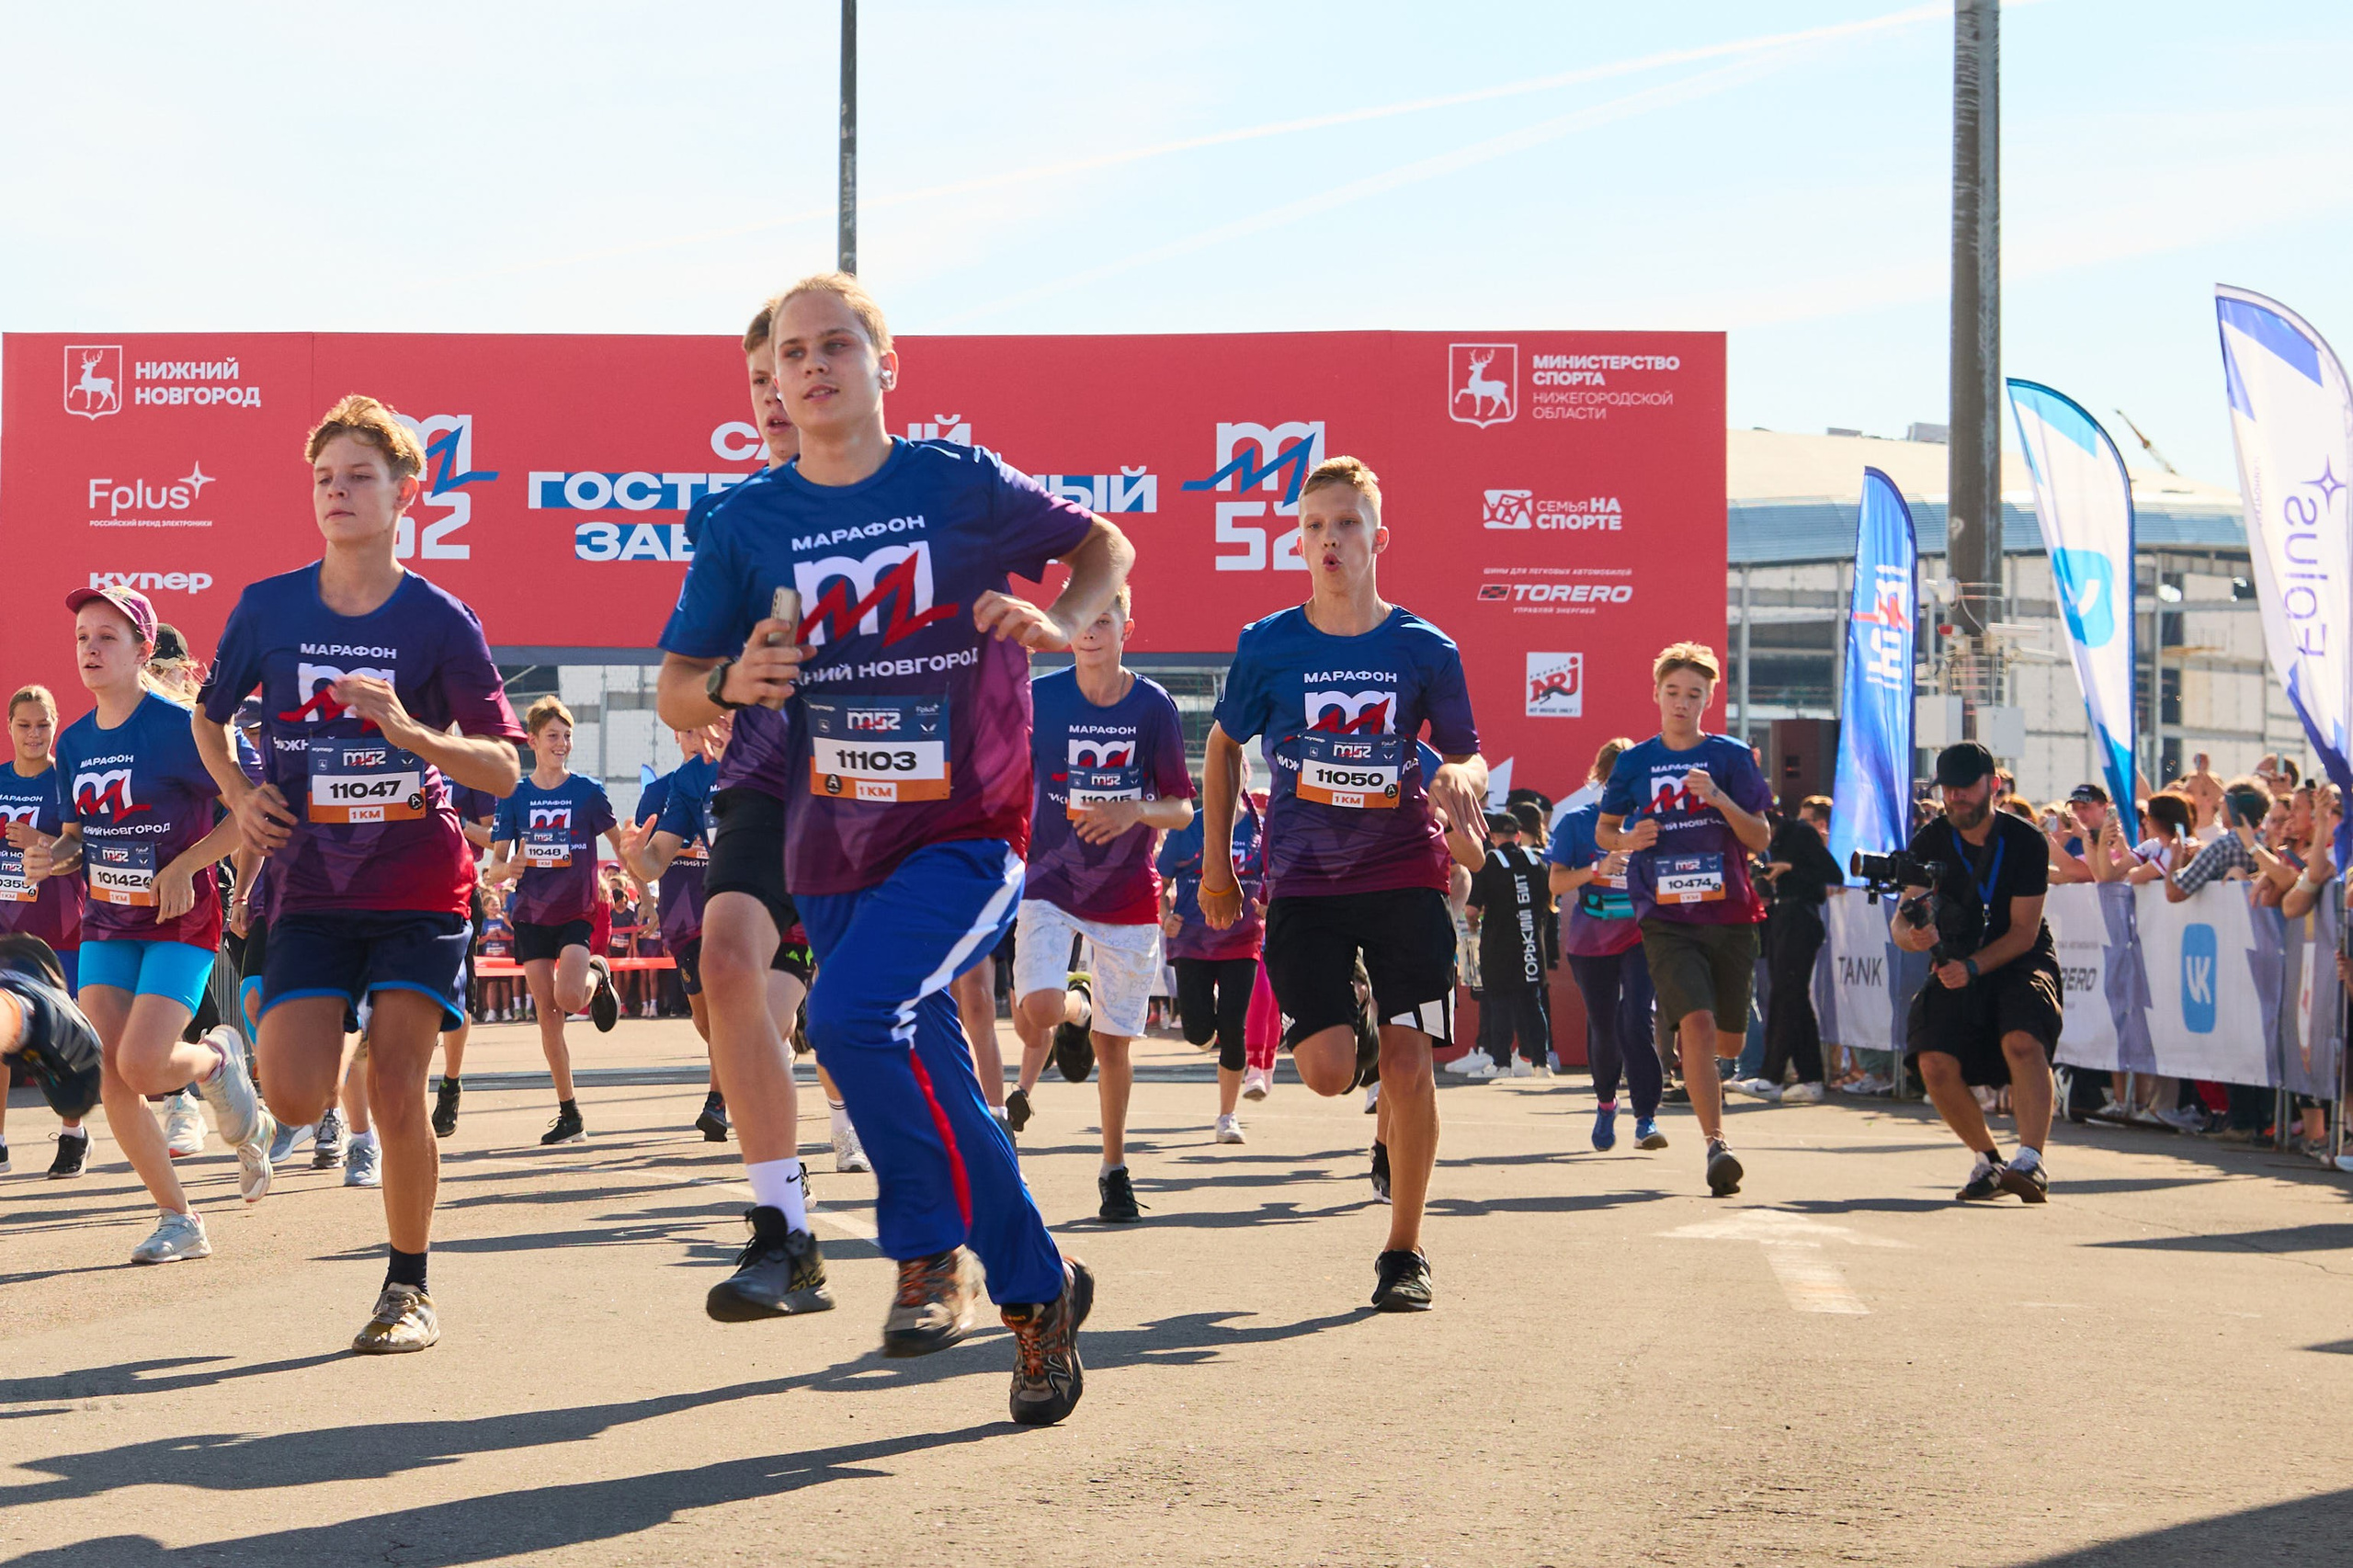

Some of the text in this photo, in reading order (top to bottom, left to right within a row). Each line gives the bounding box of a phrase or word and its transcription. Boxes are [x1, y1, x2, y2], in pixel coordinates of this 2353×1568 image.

[135, 357, 239, 380] НИЖНИЙ
[1532, 355, 1680, 370] МИНИСТЕРСТВО
[1532, 371, 1606, 386] СПОРТА
[135, 387, 261, 407] НОВГОРОД
[1532, 390, 1674, 406] НИЖЕГОРОДСКОЙ
[1532, 407, 1607, 420] ОБЛАСТИ
[89, 479, 190, 517] Fplus
[1537, 497, 1621, 513] СЕМЬЯ НА
[1536, 514, 1622, 530] СПОРТЕ
[791, 516, 926, 551] МАРАФОН
[1573, 568, 1632, 576] АВТОМОБИЛЕЙ
[89, 572, 213, 594] купер
[1513, 584, 1633, 603] TORERO
[300, 643, 397, 659] МАРАФОН
[1303, 671, 1397, 683] МАРАФОН
[1069, 725, 1137, 734] МАРАФОН
[80, 755, 134, 768] МАРАФОН
[836, 749, 917, 771] 11103
[1651, 762, 1708, 773] МАРАФОН
[1316, 768, 1384, 787] 11050
[329, 780, 402, 799] 11047
[103, 823, 170, 835] НОВГОРОД
[97, 871, 142, 887] 10142
[1668, 878, 1712, 889] 10474
[1514, 873, 1539, 983] ГОРЬКИЙ БИТ
[1837, 956, 1882, 986] TANK
